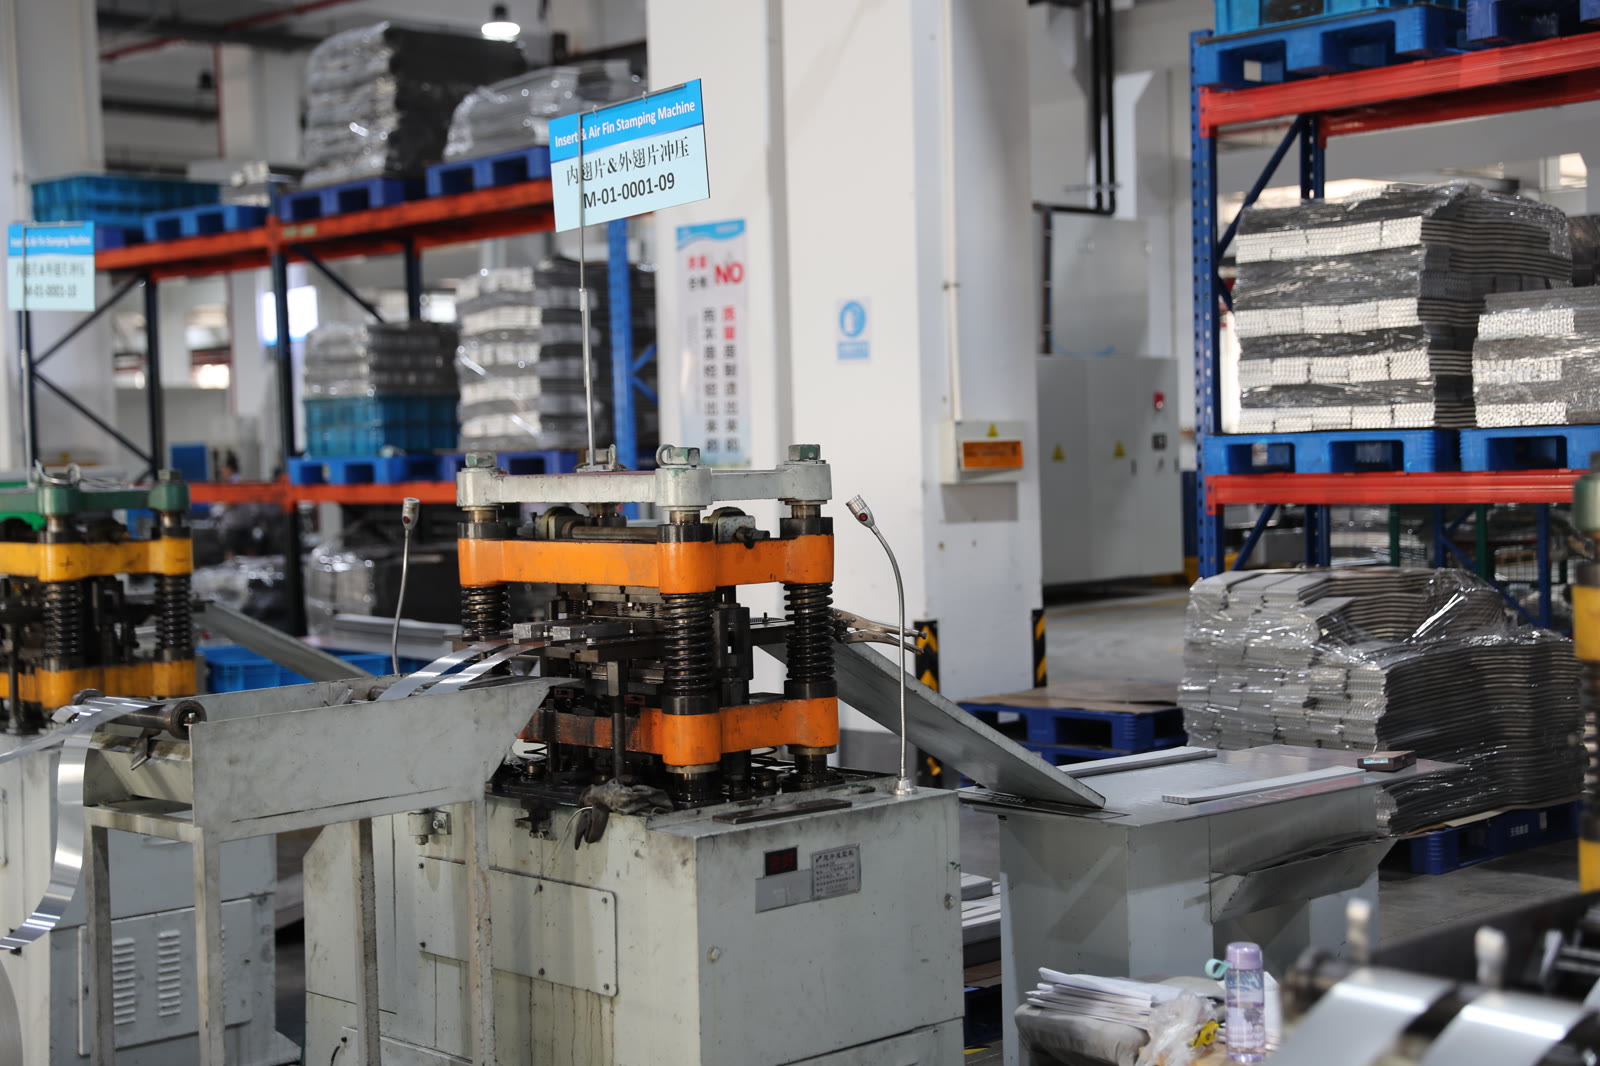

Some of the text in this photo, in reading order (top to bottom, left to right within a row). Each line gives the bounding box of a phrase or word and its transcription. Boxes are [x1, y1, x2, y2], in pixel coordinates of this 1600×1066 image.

[555, 133, 579, 148] Insert
[588, 125, 601, 139] Air
[602, 120, 615, 135] Fin
[616, 111, 657, 132] Stamping
[657, 101, 696, 119] Machine
[566, 136, 690, 187] 内翅片&外翅片冲压
[583, 172, 676, 209] M-01-0001-09
